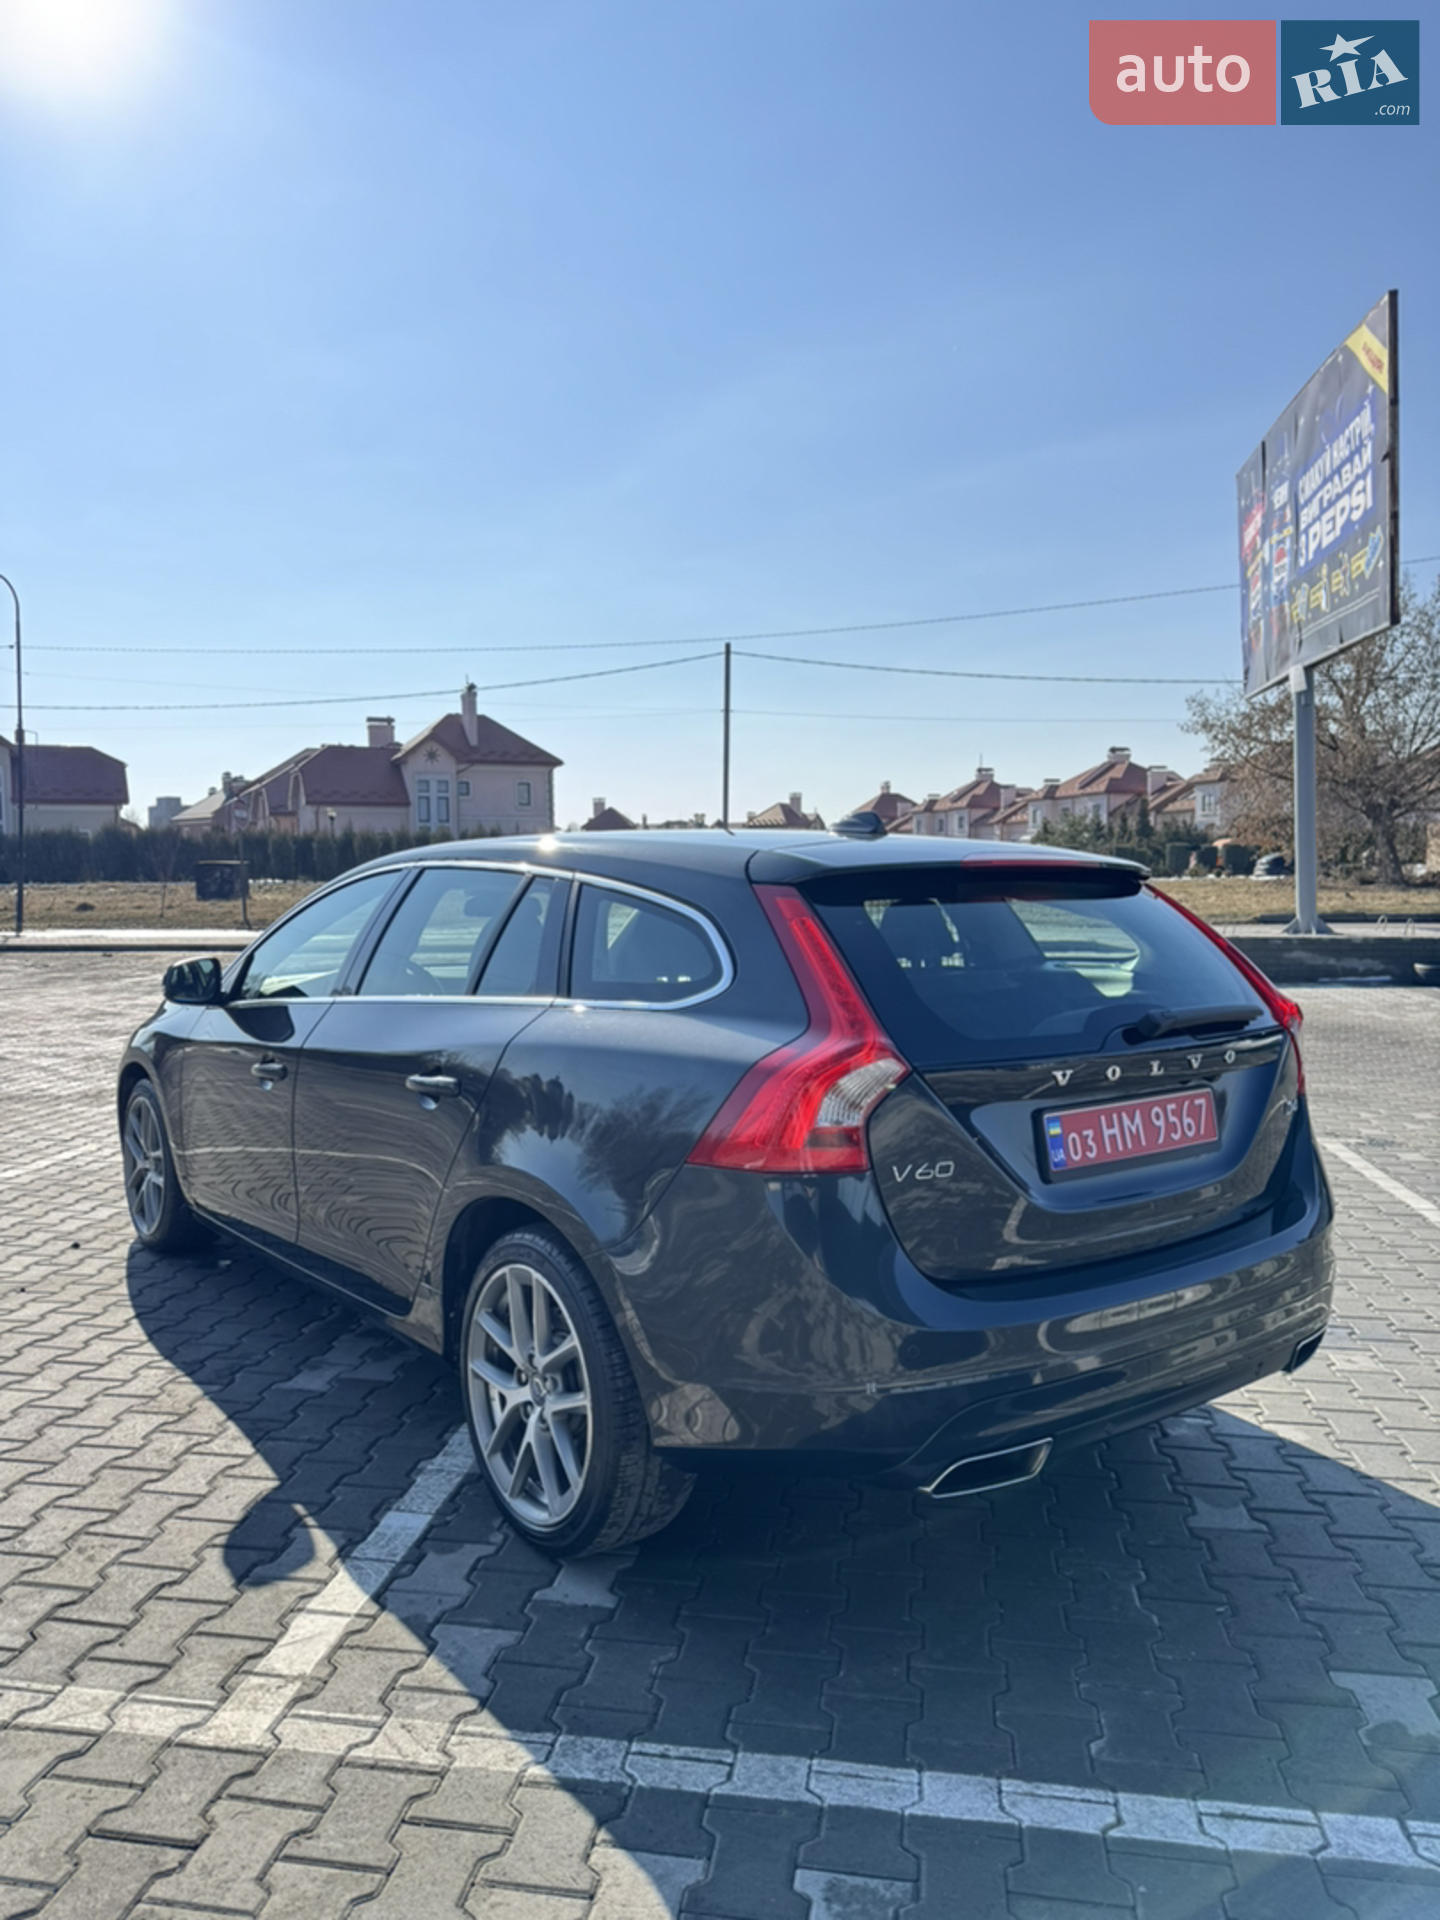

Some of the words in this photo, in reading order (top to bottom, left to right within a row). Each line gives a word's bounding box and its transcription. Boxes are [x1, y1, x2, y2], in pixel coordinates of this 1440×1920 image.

[1300, 437, 1372, 532] ВИГРАВАЙ
[1308, 469, 1373, 561] PEPSI
[1052, 1049, 1236, 1087] VOLVO
[1067, 1129, 1097, 1161] 03
[1100, 1109, 1146, 1153] HM
[1151, 1098, 1206, 1145] 9567
[892, 1161, 956, 1183] V60
